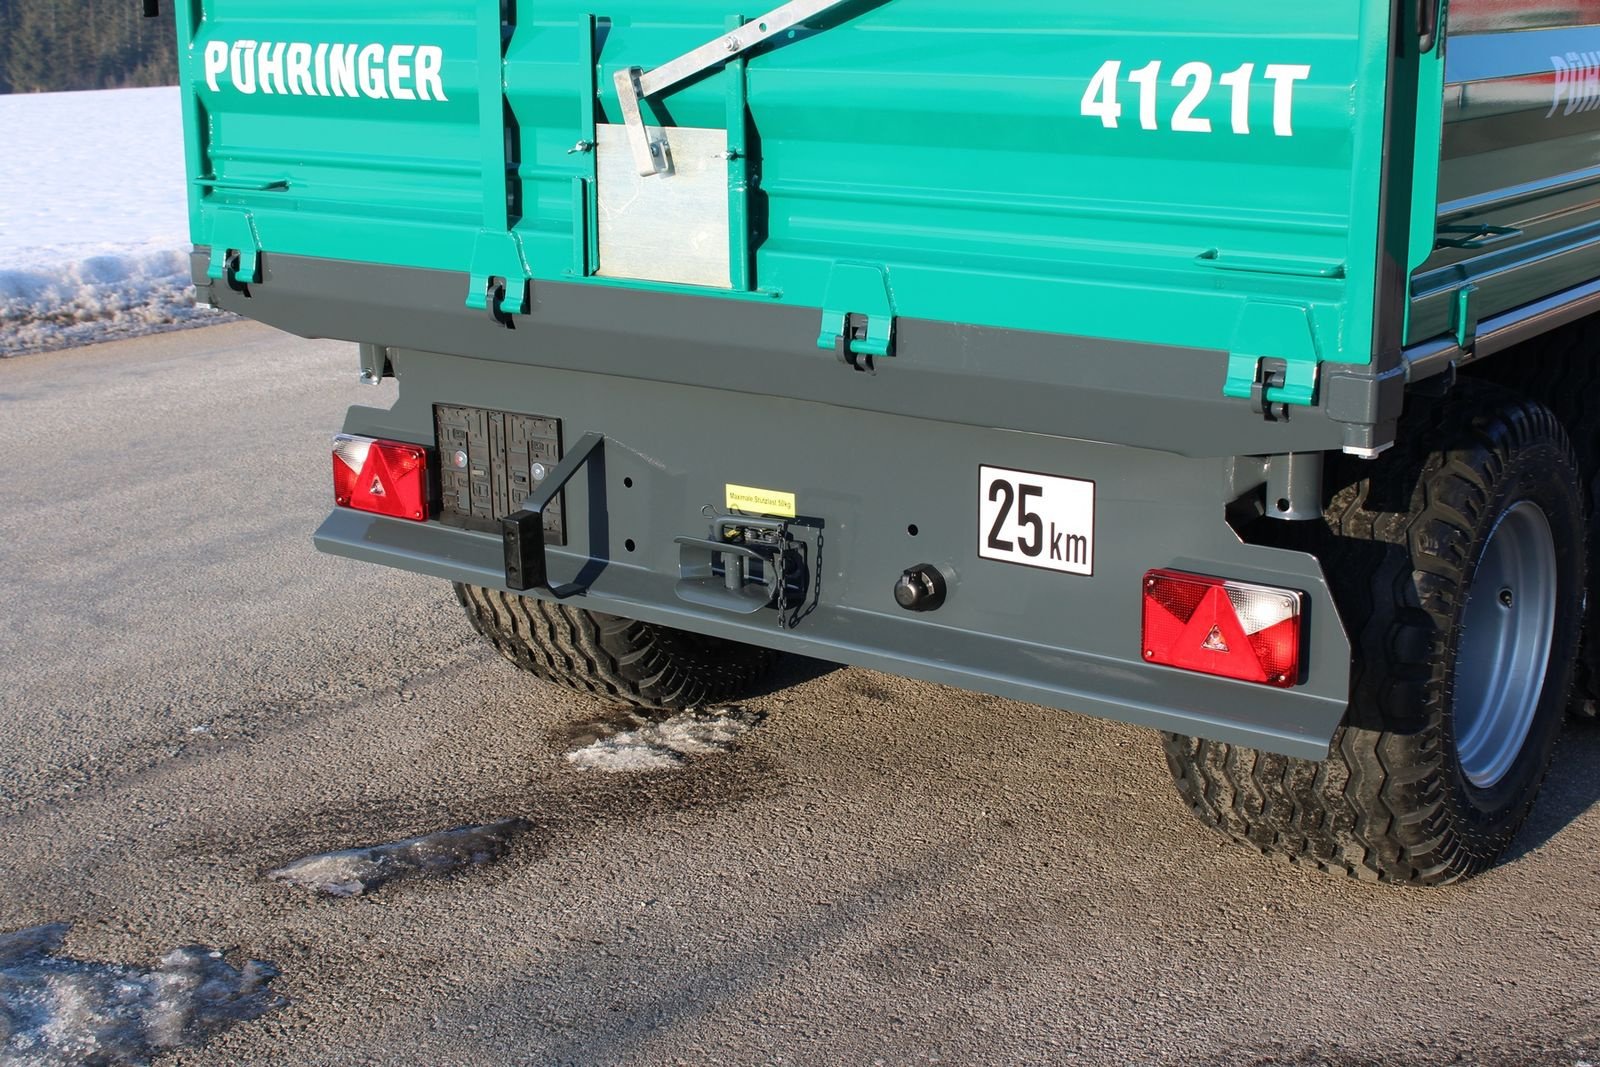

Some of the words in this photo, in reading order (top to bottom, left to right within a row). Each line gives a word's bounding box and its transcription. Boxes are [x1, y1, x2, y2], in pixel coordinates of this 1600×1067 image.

[1081, 60, 1311, 137] 4121T
[988, 478, 1043, 557] 25
[1050, 522, 1087, 565] km
